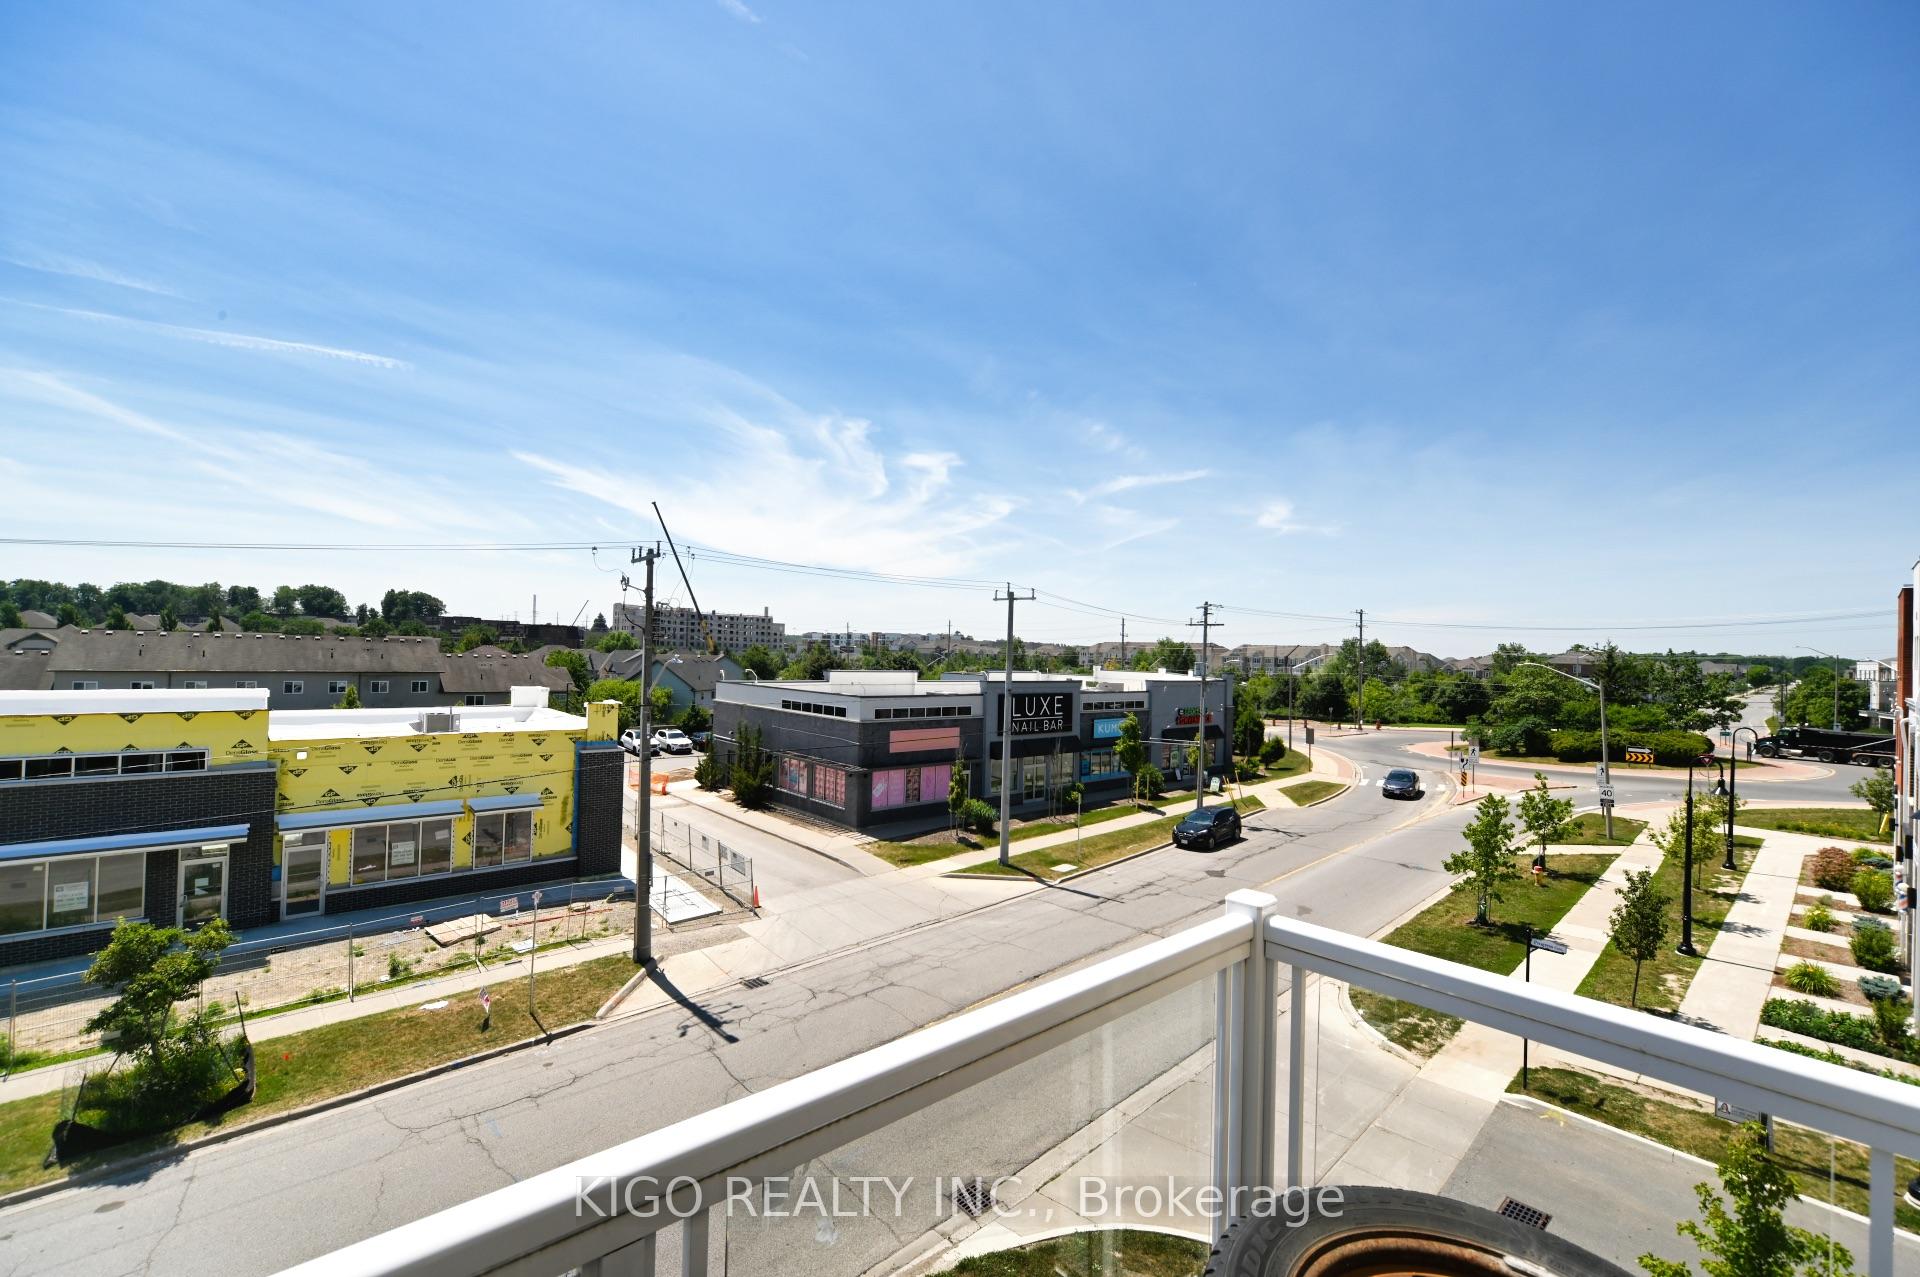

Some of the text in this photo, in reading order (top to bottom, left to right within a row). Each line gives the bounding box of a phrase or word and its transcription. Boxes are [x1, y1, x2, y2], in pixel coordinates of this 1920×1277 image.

[1012, 695, 1064, 717] LUXE
[1011, 719, 1064, 733] NAIL BAR
[1601, 789, 1613, 797] 40
